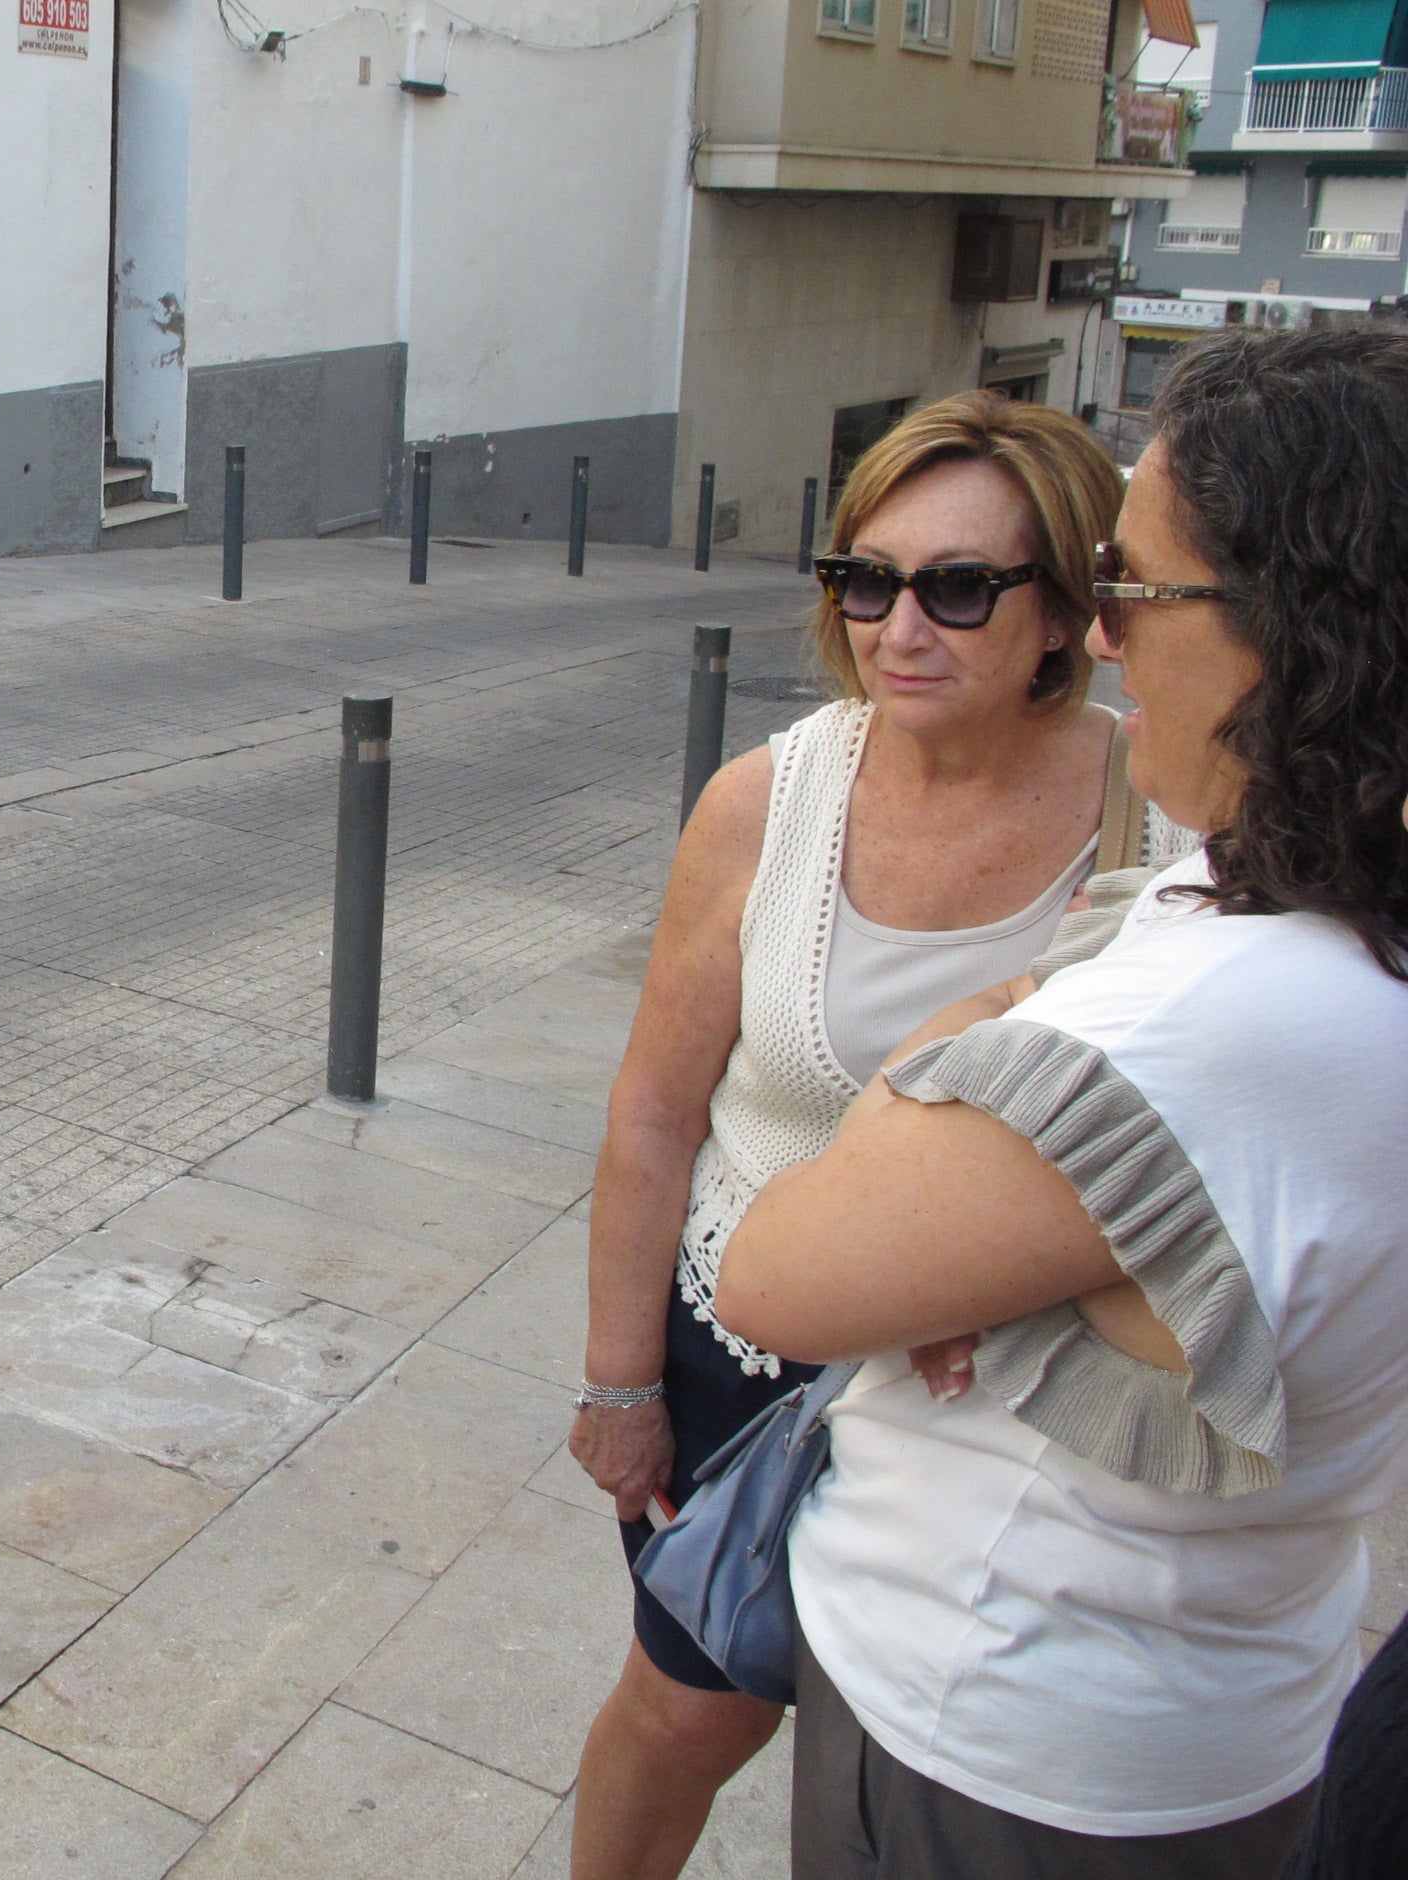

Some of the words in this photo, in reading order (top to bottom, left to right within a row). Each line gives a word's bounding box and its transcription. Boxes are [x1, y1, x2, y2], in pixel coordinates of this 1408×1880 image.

[23, 0, 44, 23] 605
[47, 0, 67, 26] 910
[69, 1, 88, 29] 503
